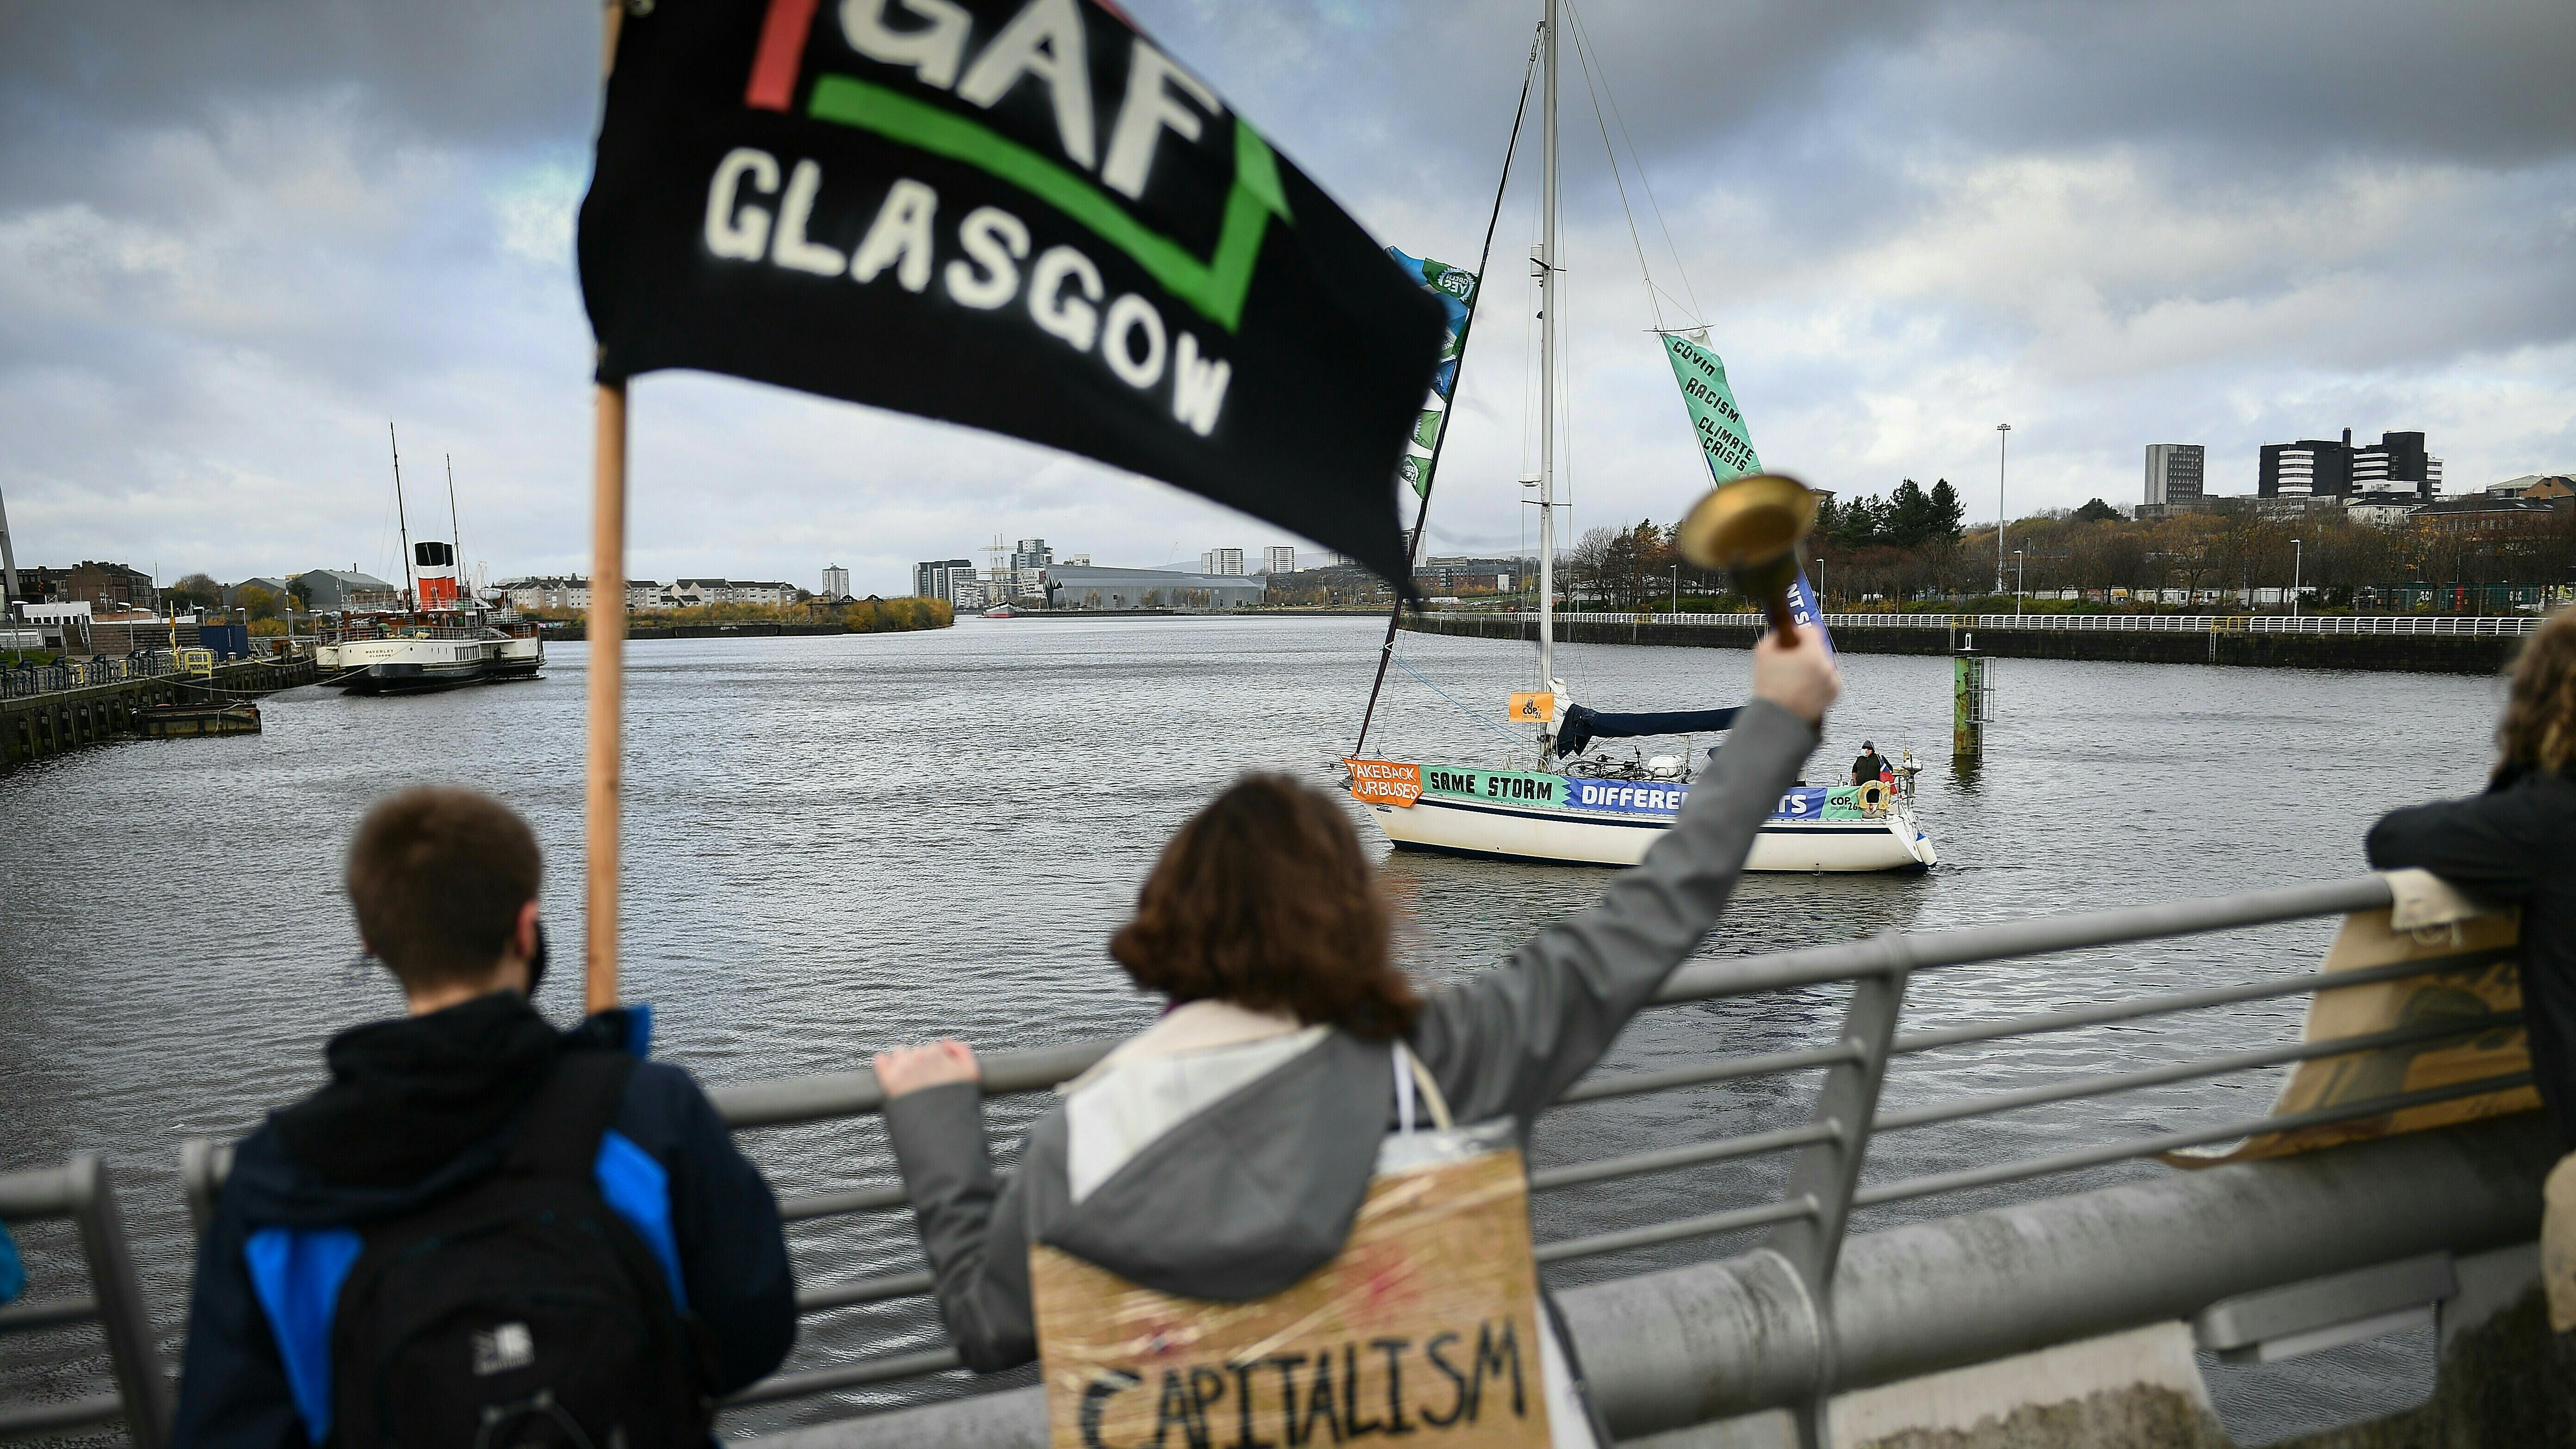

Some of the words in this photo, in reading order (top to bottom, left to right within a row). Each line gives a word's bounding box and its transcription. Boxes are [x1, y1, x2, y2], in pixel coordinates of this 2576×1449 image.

[704, 147, 1232, 436] GLASGOW
[1685, 377, 1740, 423] RACISM
[1698, 417, 1754, 461] CLIMATE
[1703, 437, 1747, 472] CRISIS
[1430, 772, 1475, 794] SAME
[1488, 777, 1552, 800] STORM
[1582, 785, 1689, 810] DIFFERE
[1830, 797, 1850, 805] COP
[1848, 802, 1858, 810] 26
[1078, 1315, 1525, 1449] CAPITALISM
